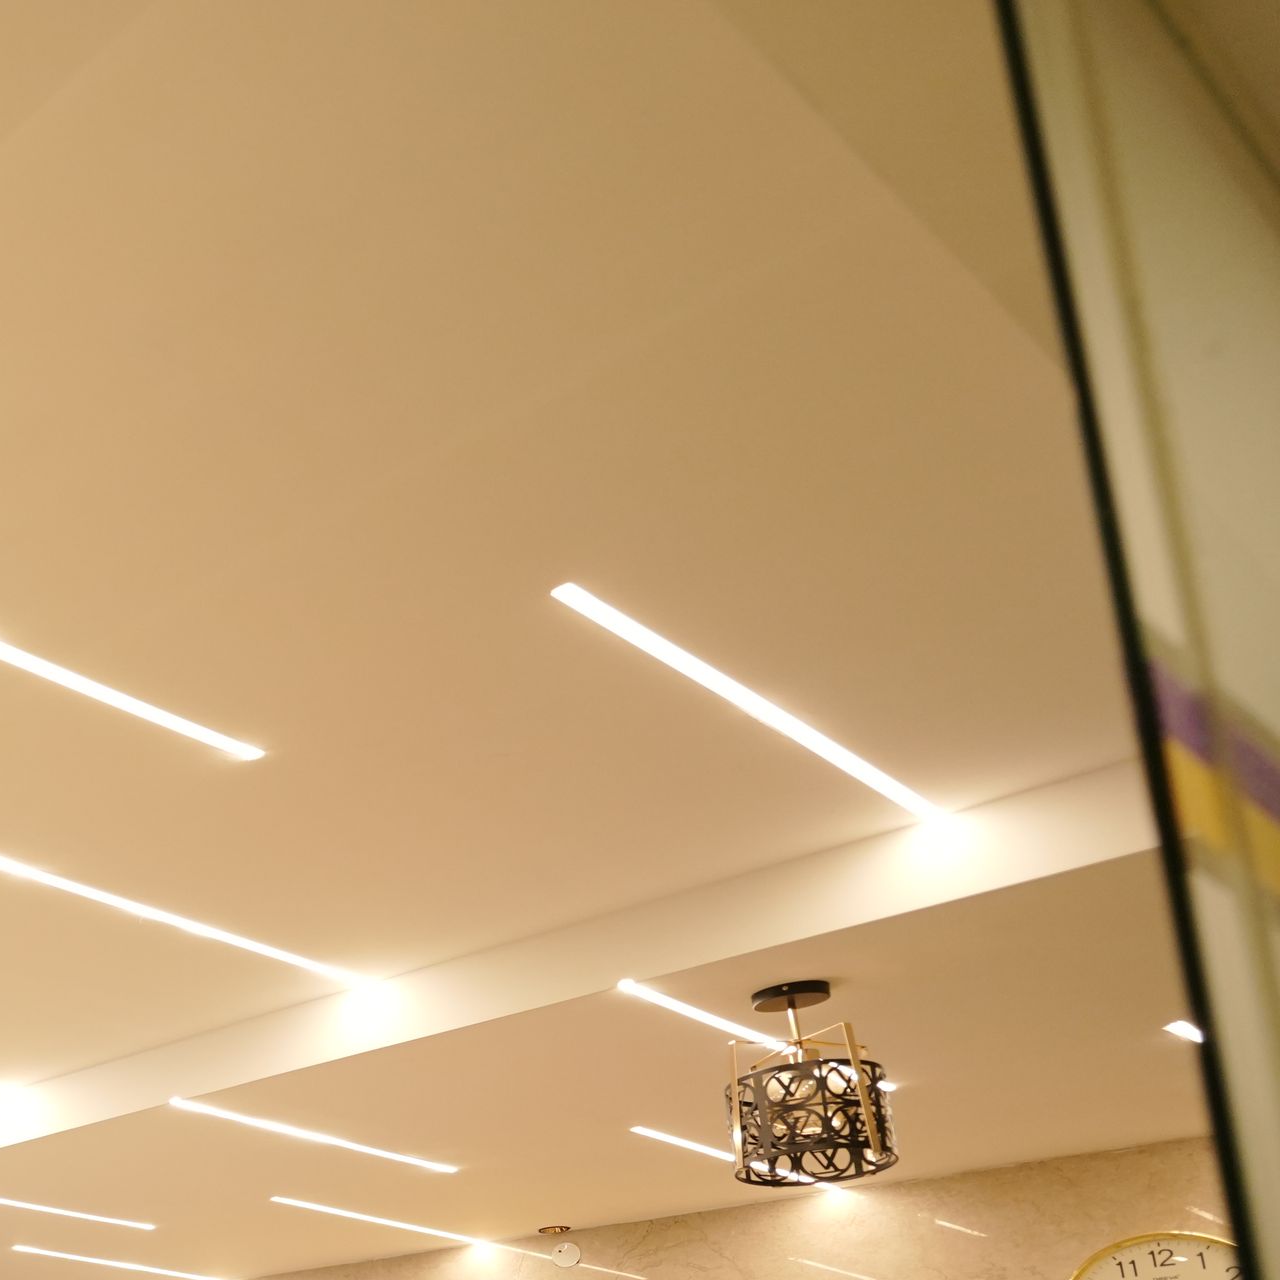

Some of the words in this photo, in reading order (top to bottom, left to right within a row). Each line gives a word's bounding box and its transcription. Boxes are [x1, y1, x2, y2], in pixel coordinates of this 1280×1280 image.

[1148, 1249, 1175, 1267] 12
[1197, 1252, 1206, 1269] 1
[1116, 1260, 1138, 1278] 11
